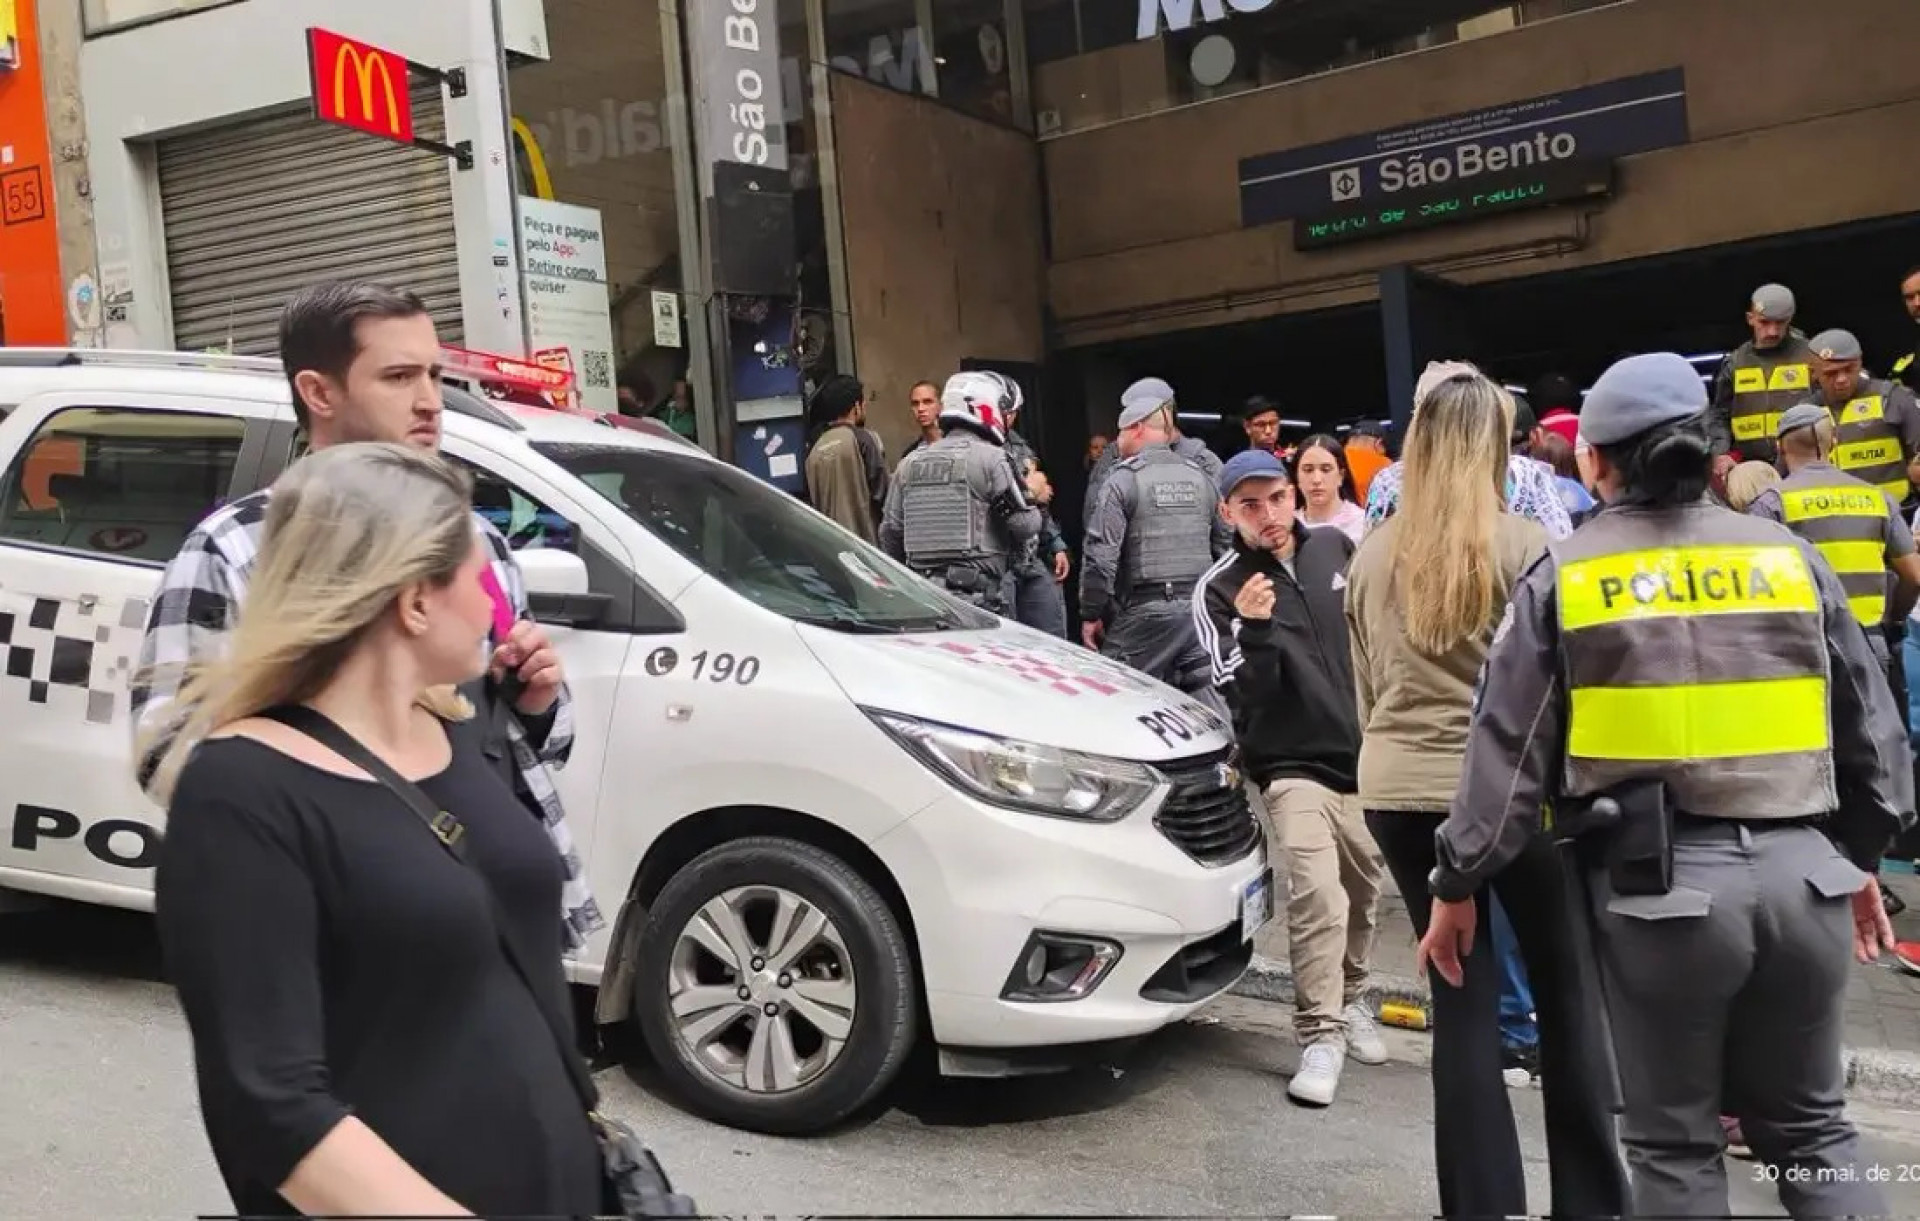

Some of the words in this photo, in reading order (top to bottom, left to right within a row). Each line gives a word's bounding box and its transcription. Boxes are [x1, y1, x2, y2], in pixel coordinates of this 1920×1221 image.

[730, 69, 768, 164] São
[1379, 151, 1452, 192] São
[1456, 131, 1576, 178] Bento
[9, 181, 36, 213] 55
[526, 239, 551, 253] pelo
[1600, 561, 1776, 608] POLÍCIA
[691, 649, 760, 686] 190
